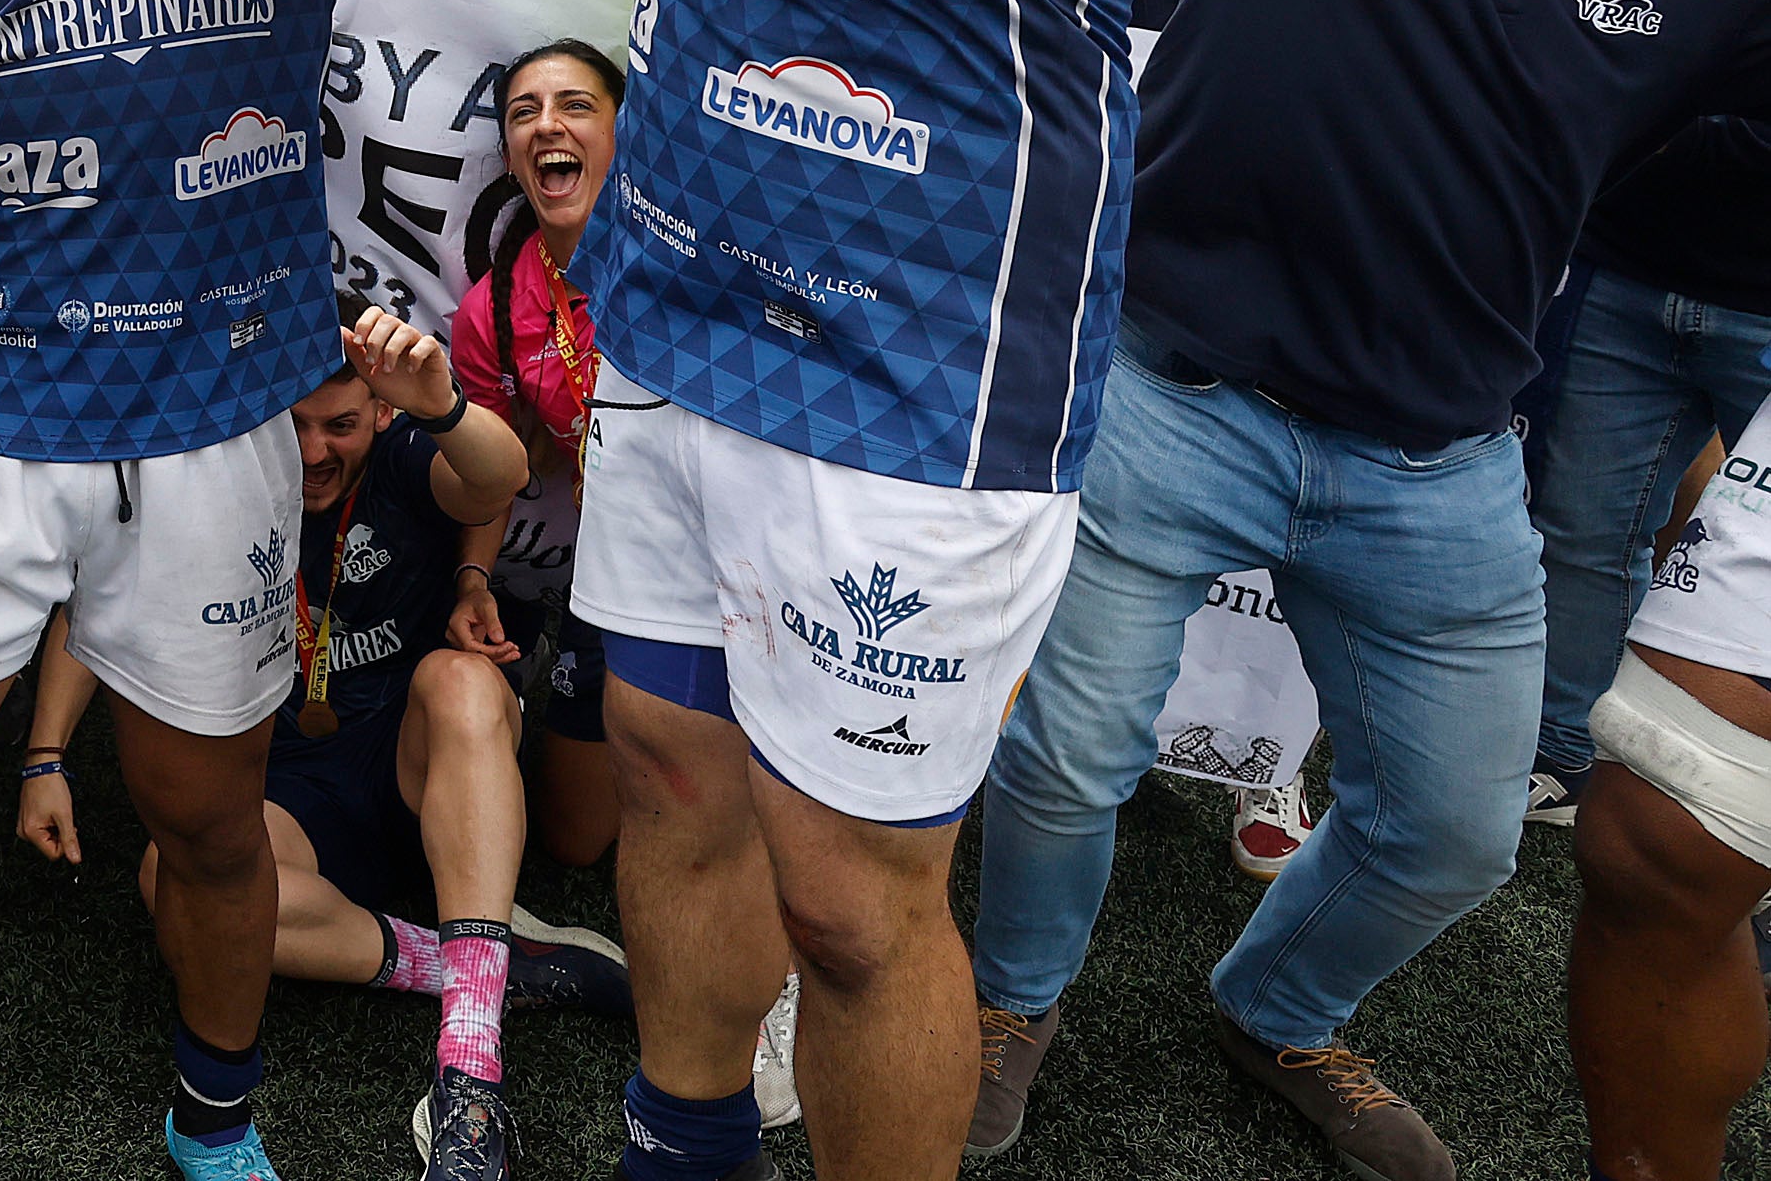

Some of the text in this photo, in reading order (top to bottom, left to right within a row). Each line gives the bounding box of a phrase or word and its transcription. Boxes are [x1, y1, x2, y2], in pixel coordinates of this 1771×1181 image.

[707, 75, 917, 167] LEVANOVA
[180, 135, 304, 195] LEVANOVA
[632, 185, 697, 242] DIPUTACIÓN
[632, 208, 697, 259] DE VALLADOLID
[200, 265, 291, 304] CASTILLA Y LEÓN
[719, 240, 879, 303] CASTILLA Y LEÓN
[755, 269, 827, 306] NOS IMPULSA
[93, 298, 183, 319] DIPUTACIÓN
[225, 297, 241, 307] NOS
[24, 324, 37, 334] de
[93, 317, 183, 334] DE VALLADOLID
[201, 595, 259, 626] CAJA
[240, 622, 254, 637] DE
[781, 600, 966, 684] CAJA RURAL
[811, 651, 918, 701] DE ZAMORA
[832, 725, 932, 757] MERCURY
